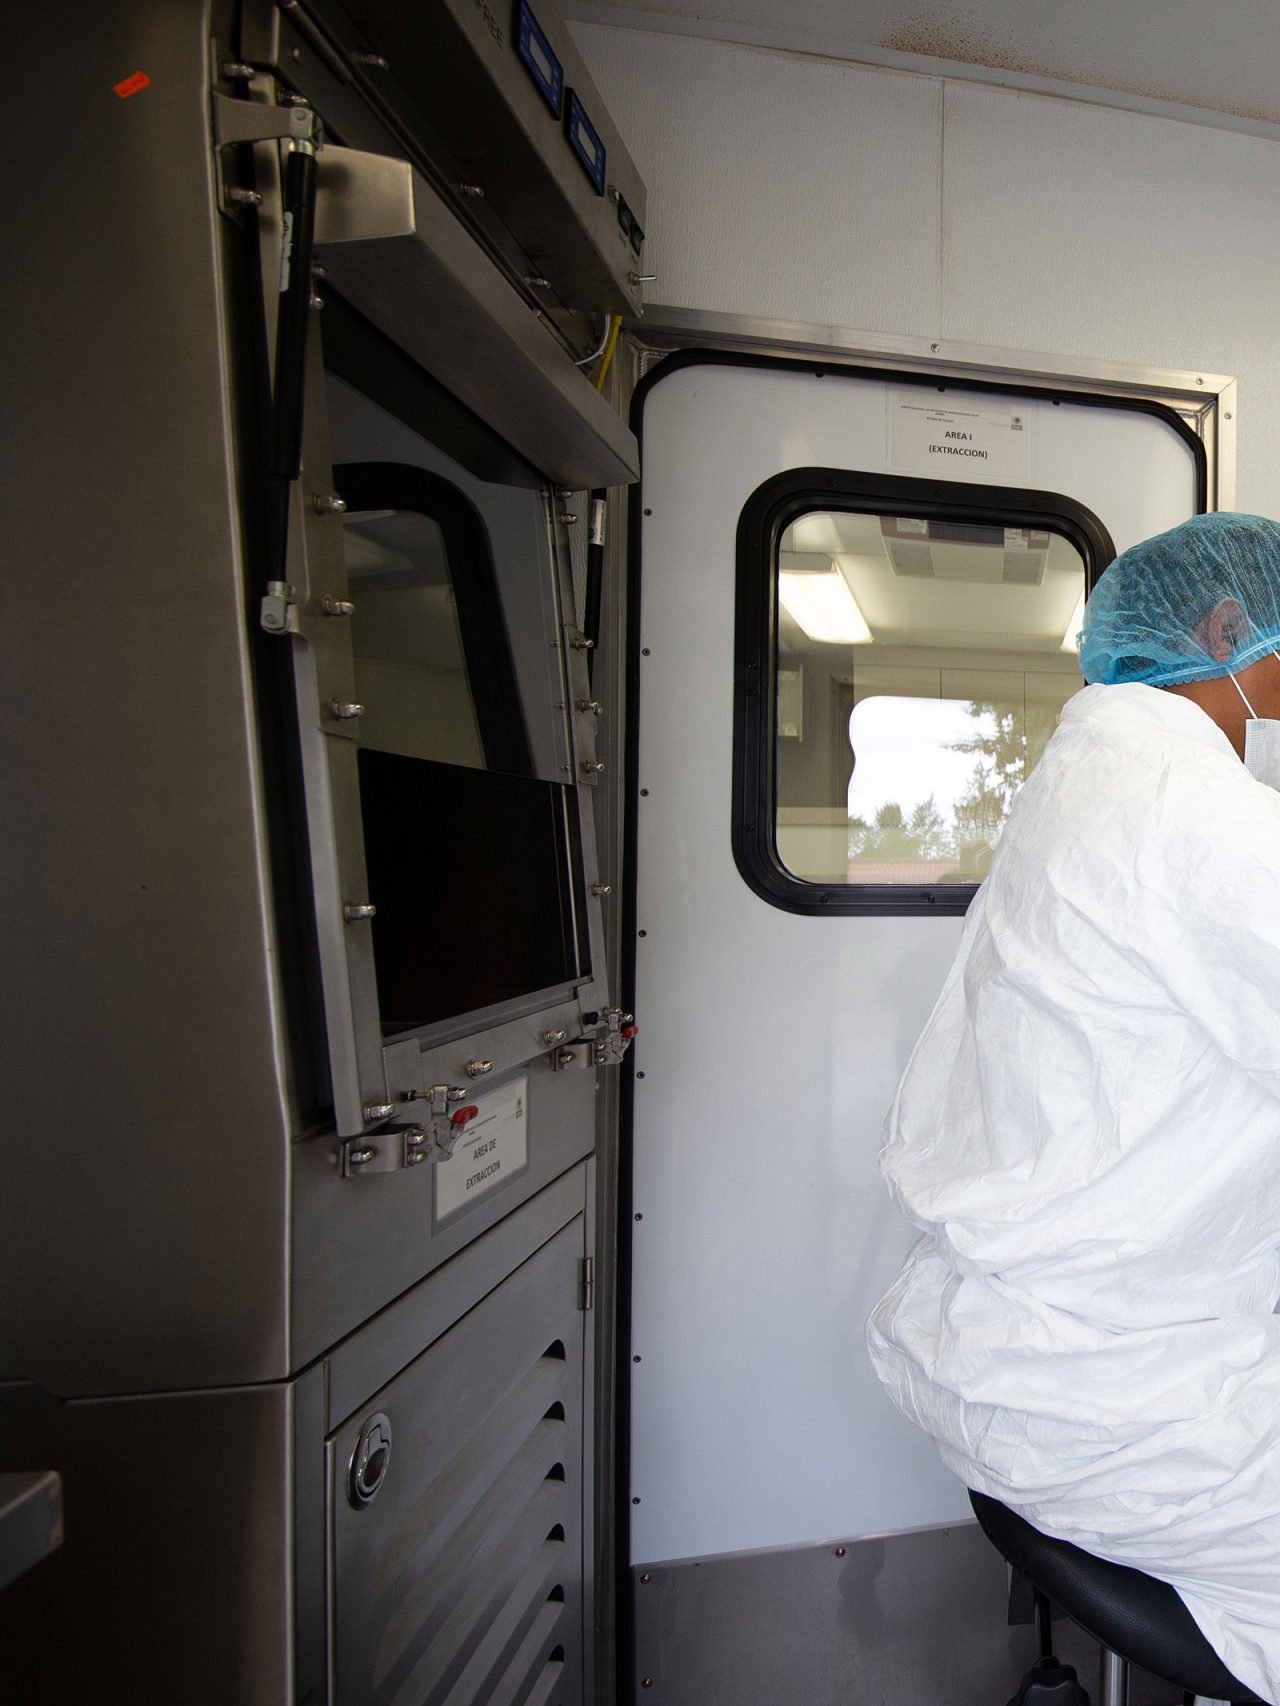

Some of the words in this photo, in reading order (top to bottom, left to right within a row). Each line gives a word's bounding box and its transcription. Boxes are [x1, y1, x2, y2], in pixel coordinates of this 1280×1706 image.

[945, 431, 967, 441] AREA
[969, 433, 972, 441] I
[929, 444, 988, 460] (EXTRACCION)
[473, 1142, 488, 1160] AREA
[489, 1138, 497, 1152] DE
[466, 1160, 501, 1190] EXTRACCION
